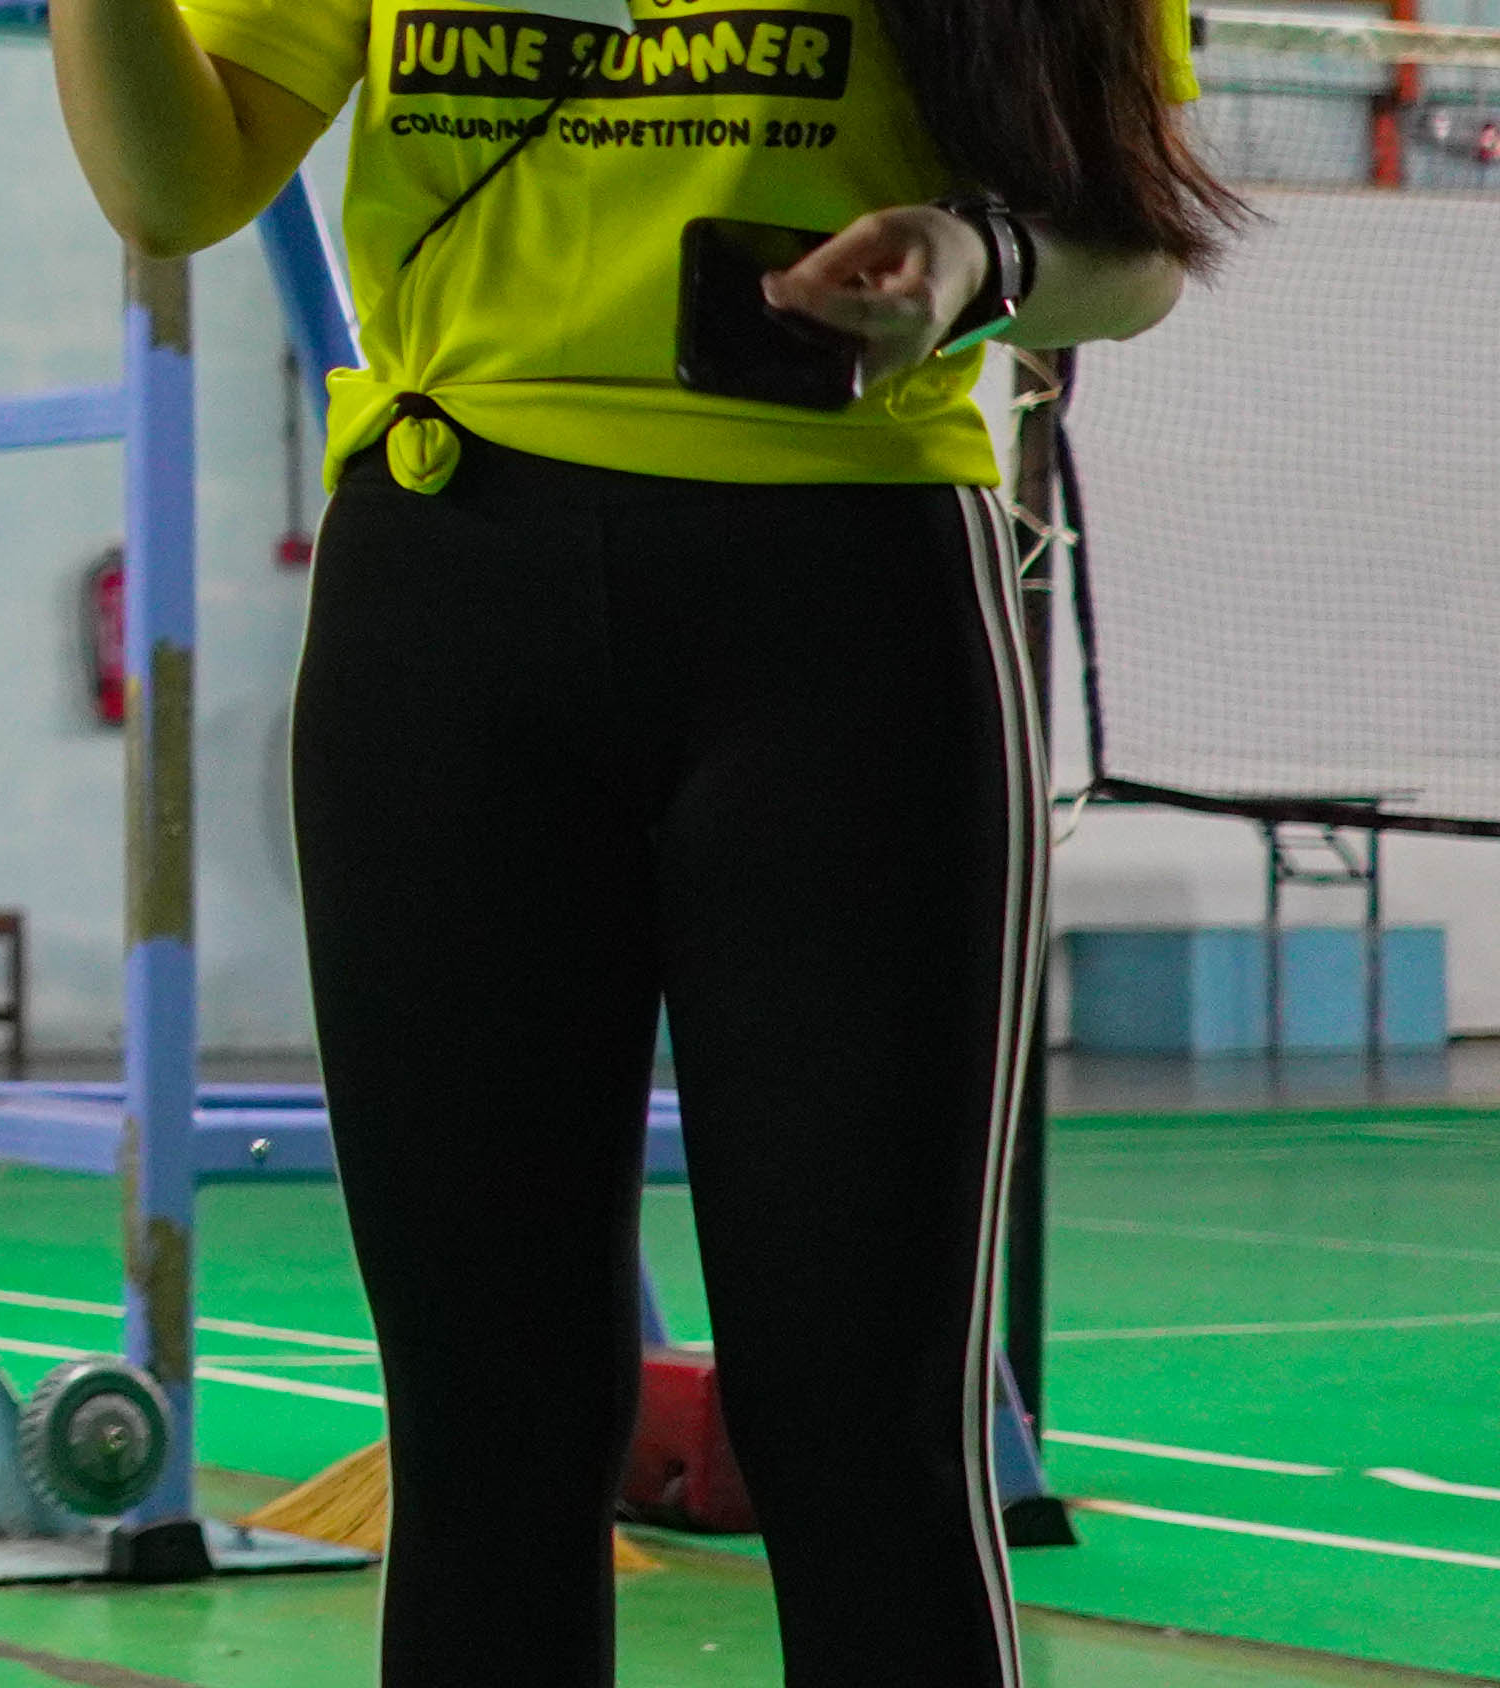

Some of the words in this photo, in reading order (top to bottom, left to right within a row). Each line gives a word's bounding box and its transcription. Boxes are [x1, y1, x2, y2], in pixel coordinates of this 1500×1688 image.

[398, 22, 549, 82] JUNE
[566, 20, 831, 86] SUMMER
[558, 116, 750, 150] COMPETITION
[764, 119, 838, 149] 2019
